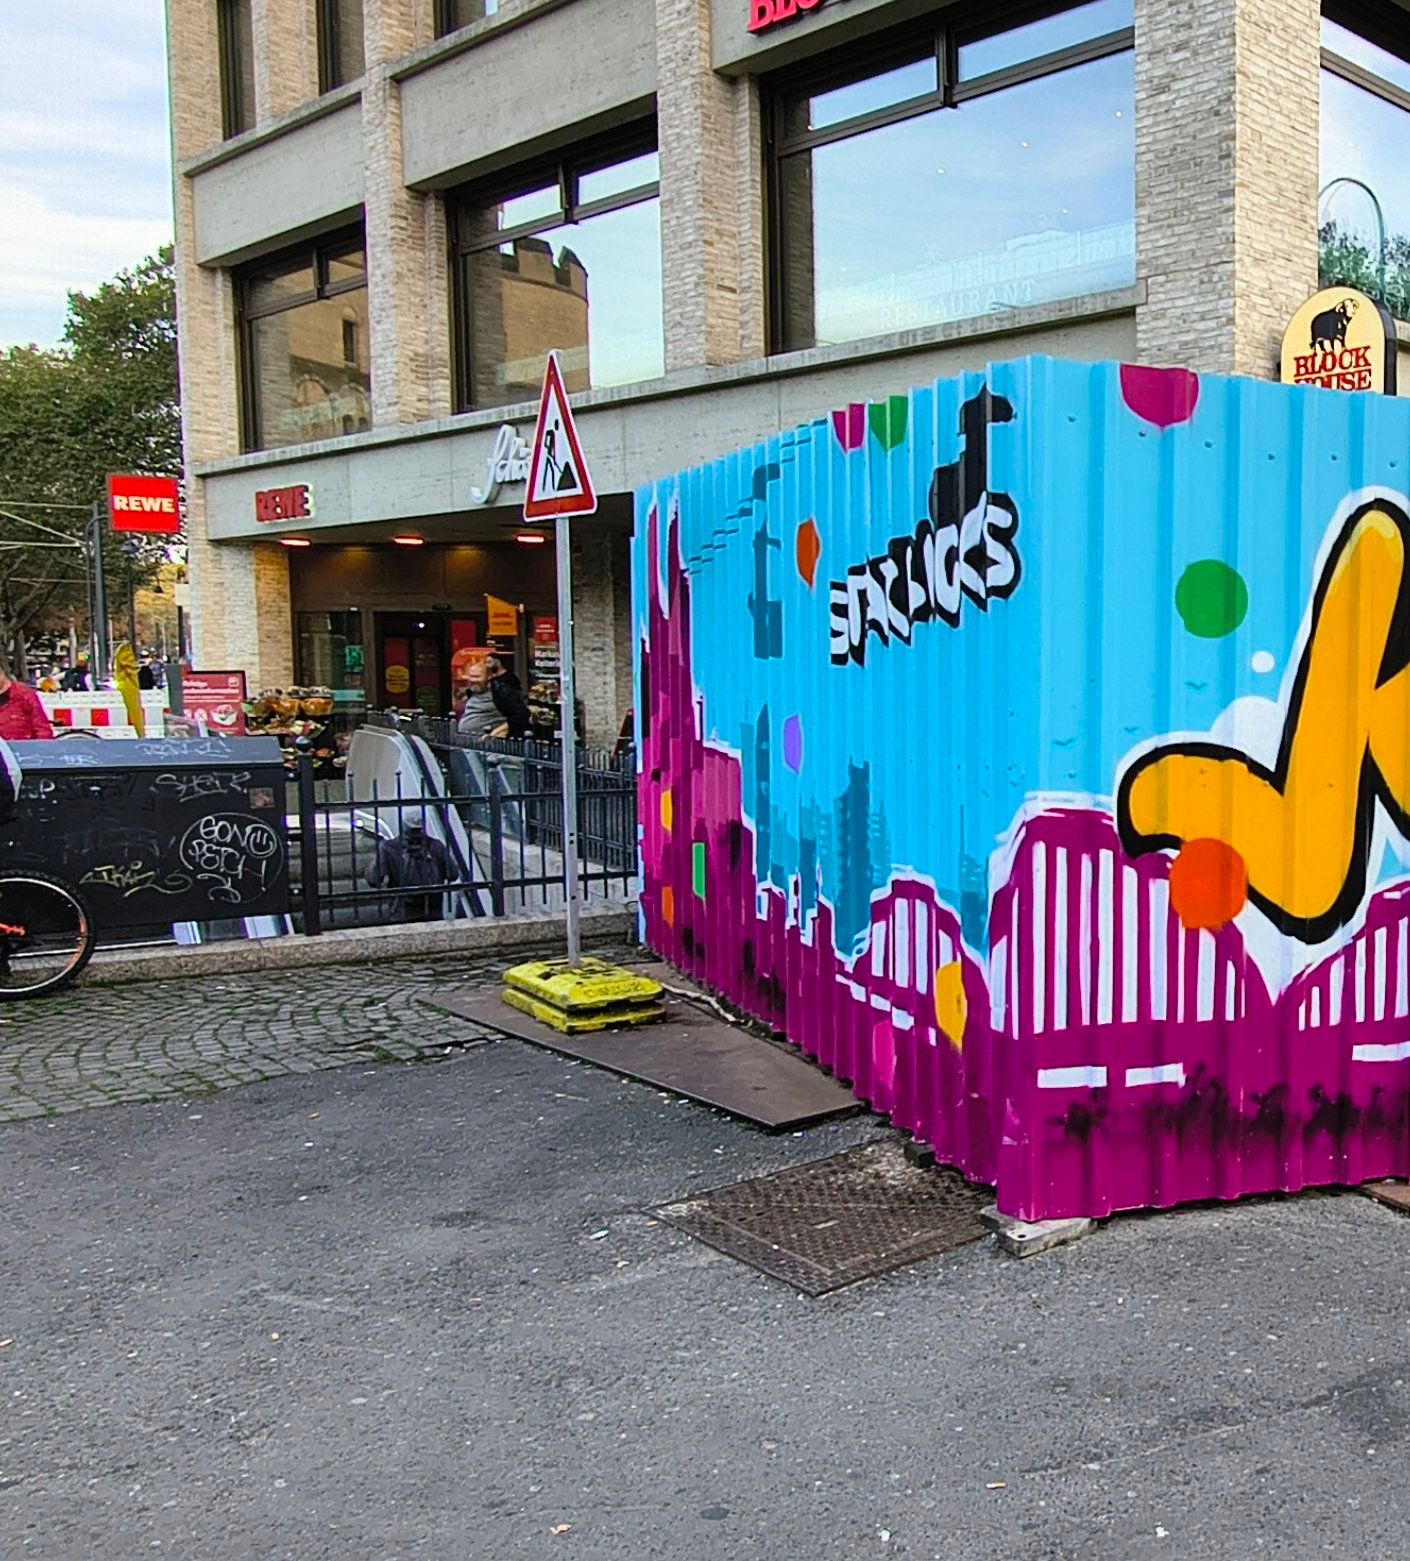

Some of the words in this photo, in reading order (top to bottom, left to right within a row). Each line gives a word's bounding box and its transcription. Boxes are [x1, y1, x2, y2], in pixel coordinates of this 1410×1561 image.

[1293, 346, 1372, 378] BLOCK
[1293, 369, 1372, 391] USE
[113, 495, 175, 514] REWE
[255, 484, 312, 522] REWE
